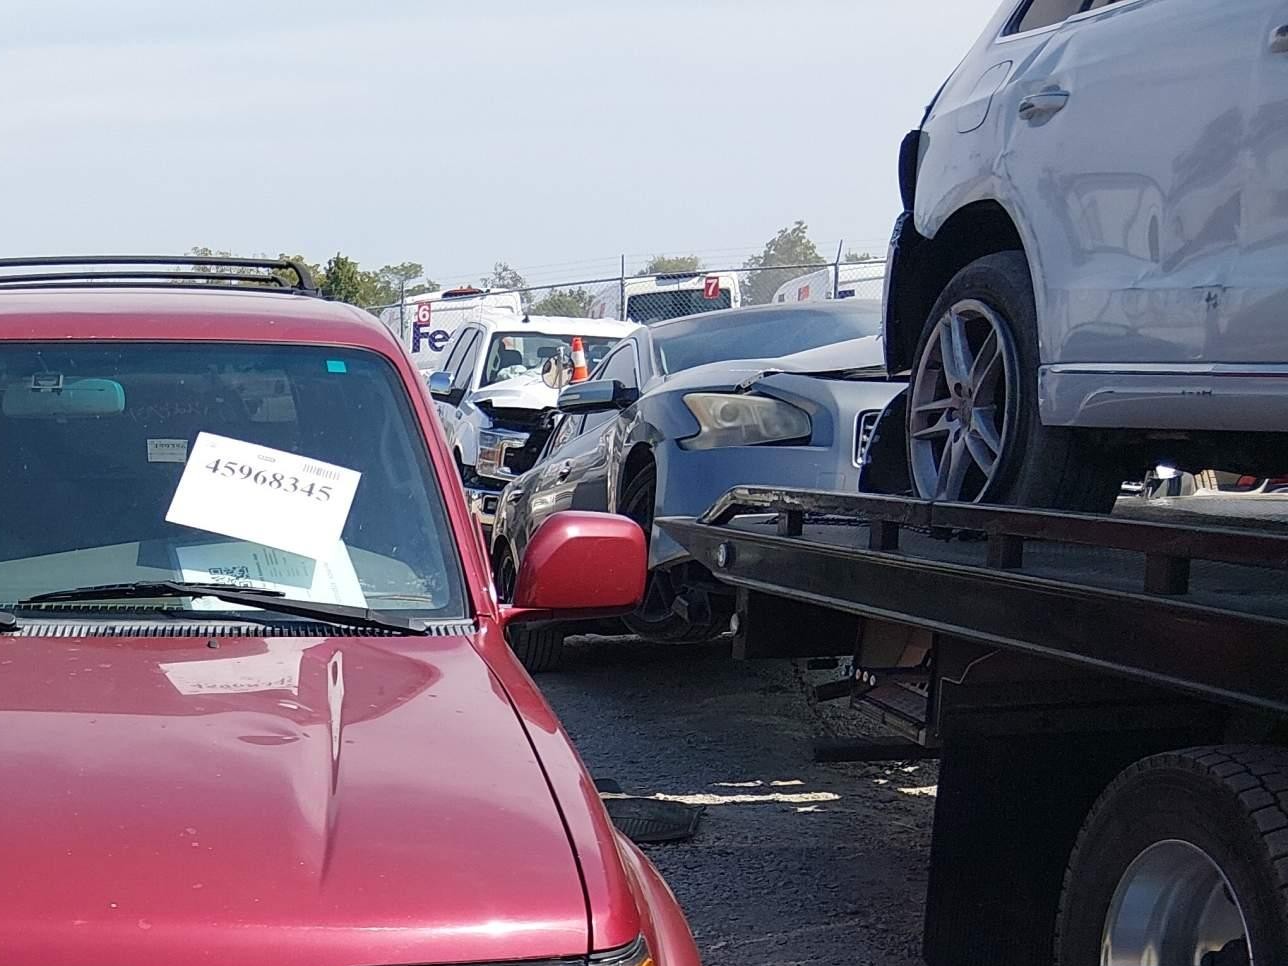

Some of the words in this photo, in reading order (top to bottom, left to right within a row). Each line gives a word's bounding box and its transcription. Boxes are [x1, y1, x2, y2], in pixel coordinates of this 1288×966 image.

[706, 278, 718, 296] 7
[418, 305, 430, 322] 6
[204, 457, 334, 502] 45968345
